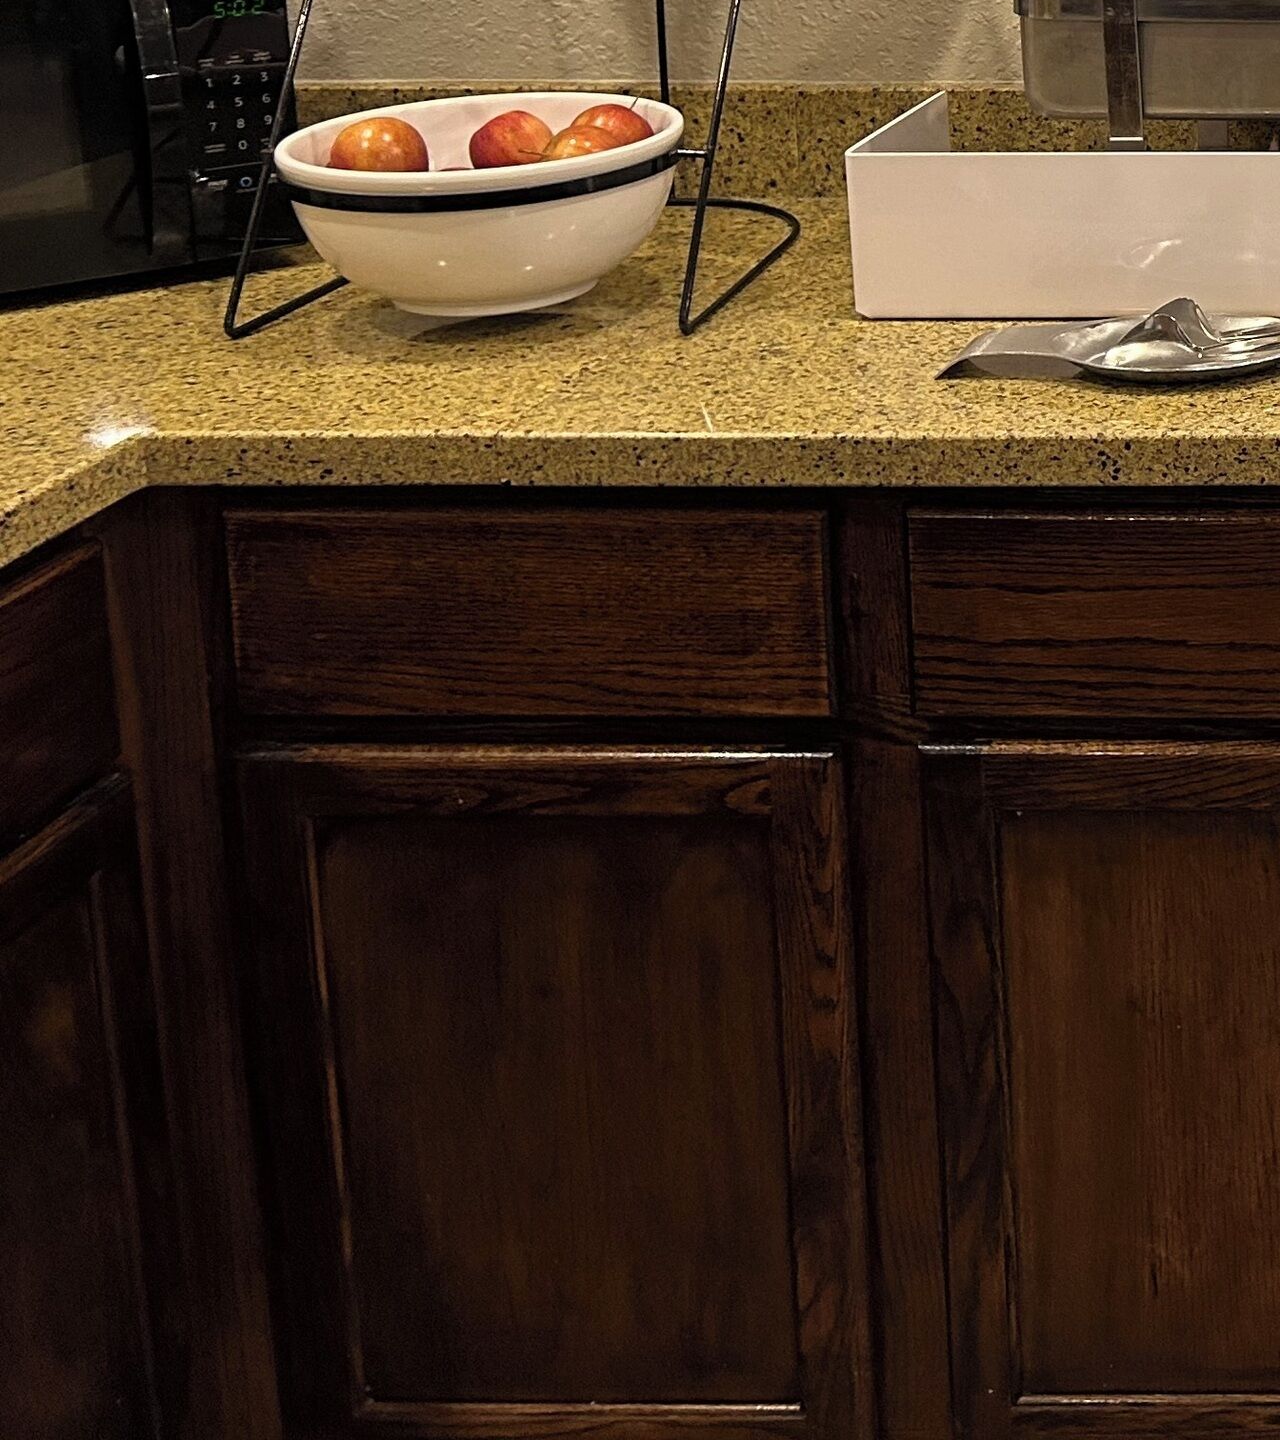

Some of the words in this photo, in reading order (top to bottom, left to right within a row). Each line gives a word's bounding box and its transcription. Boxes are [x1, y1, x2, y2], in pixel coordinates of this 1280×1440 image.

[205, 78, 213, 88] 1
[232, 74, 241, 85] 2
[260, 71, 269, 82] 3
[234, 96, 243, 107] 5
[261, 93, 271, 104] 6
[208, 121, 217, 132] 7
[236, 117, 246, 129] 8
[263, 114, 273, 125] 9
[238, 139, 248, 150] 0
